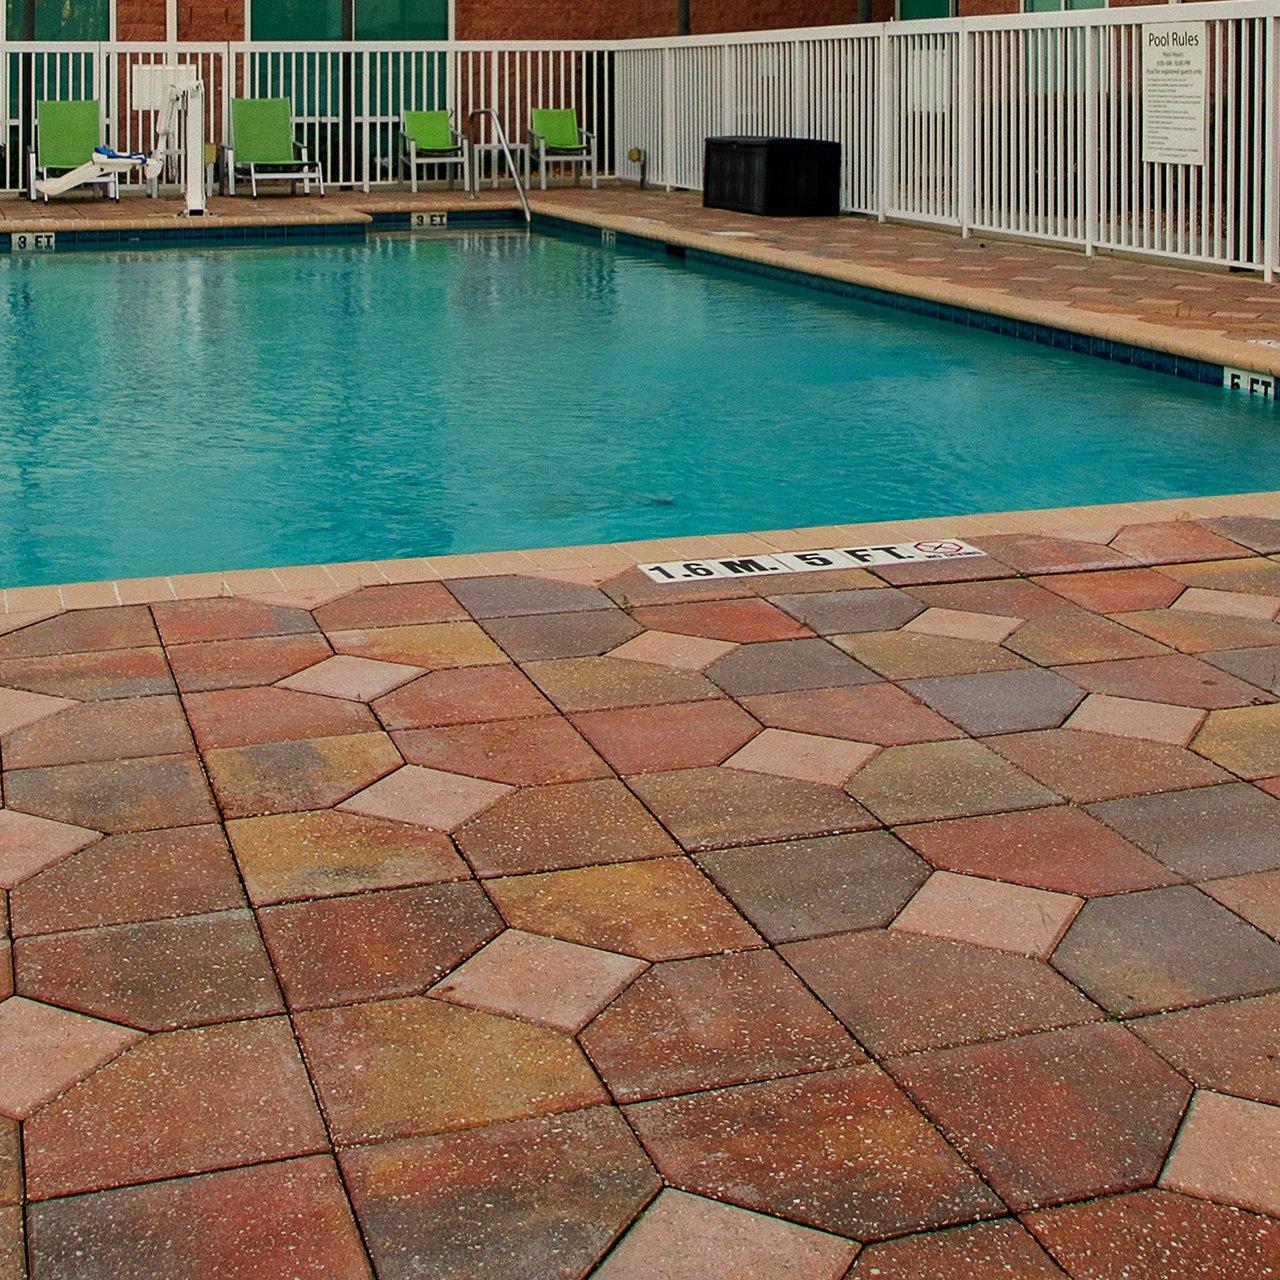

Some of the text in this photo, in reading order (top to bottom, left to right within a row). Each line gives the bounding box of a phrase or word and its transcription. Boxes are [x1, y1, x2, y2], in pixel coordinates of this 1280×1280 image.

[1148, 31, 1199, 47] Pool Rules
[416, 214, 425, 226] 3
[18, 235, 28, 249] 3
[1250, 377, 1272, 397] FT
[648, 546, 915, 579] 1.6 M. 5 FT.
